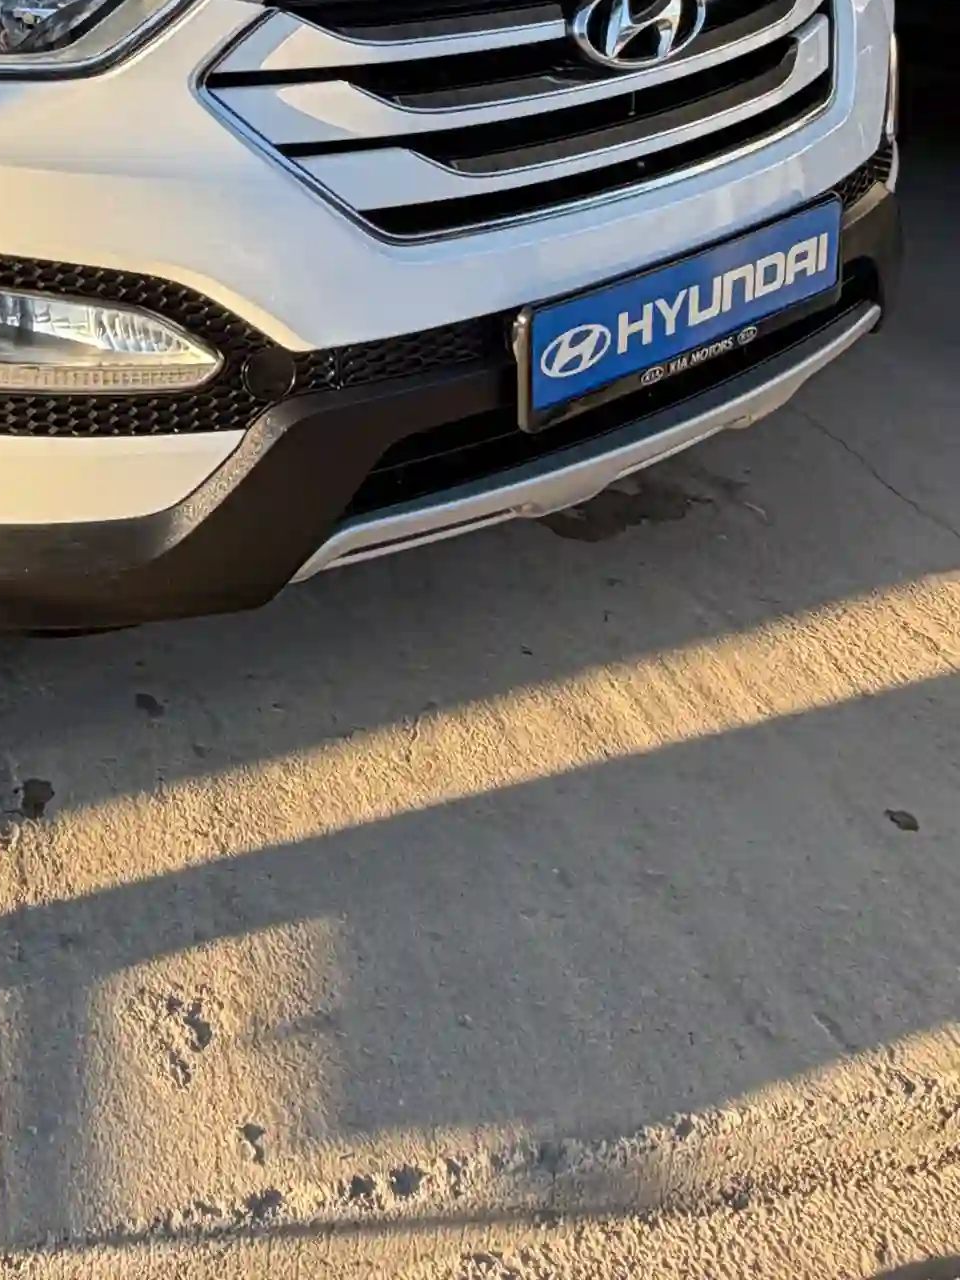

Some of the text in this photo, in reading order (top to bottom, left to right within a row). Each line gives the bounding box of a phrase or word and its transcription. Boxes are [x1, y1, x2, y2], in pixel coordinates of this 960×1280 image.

[617, 233, 828, 355] HYUNDAI
[668, 357, 689, 376] KIA
[690, 337, 734, 367] MOTORS
